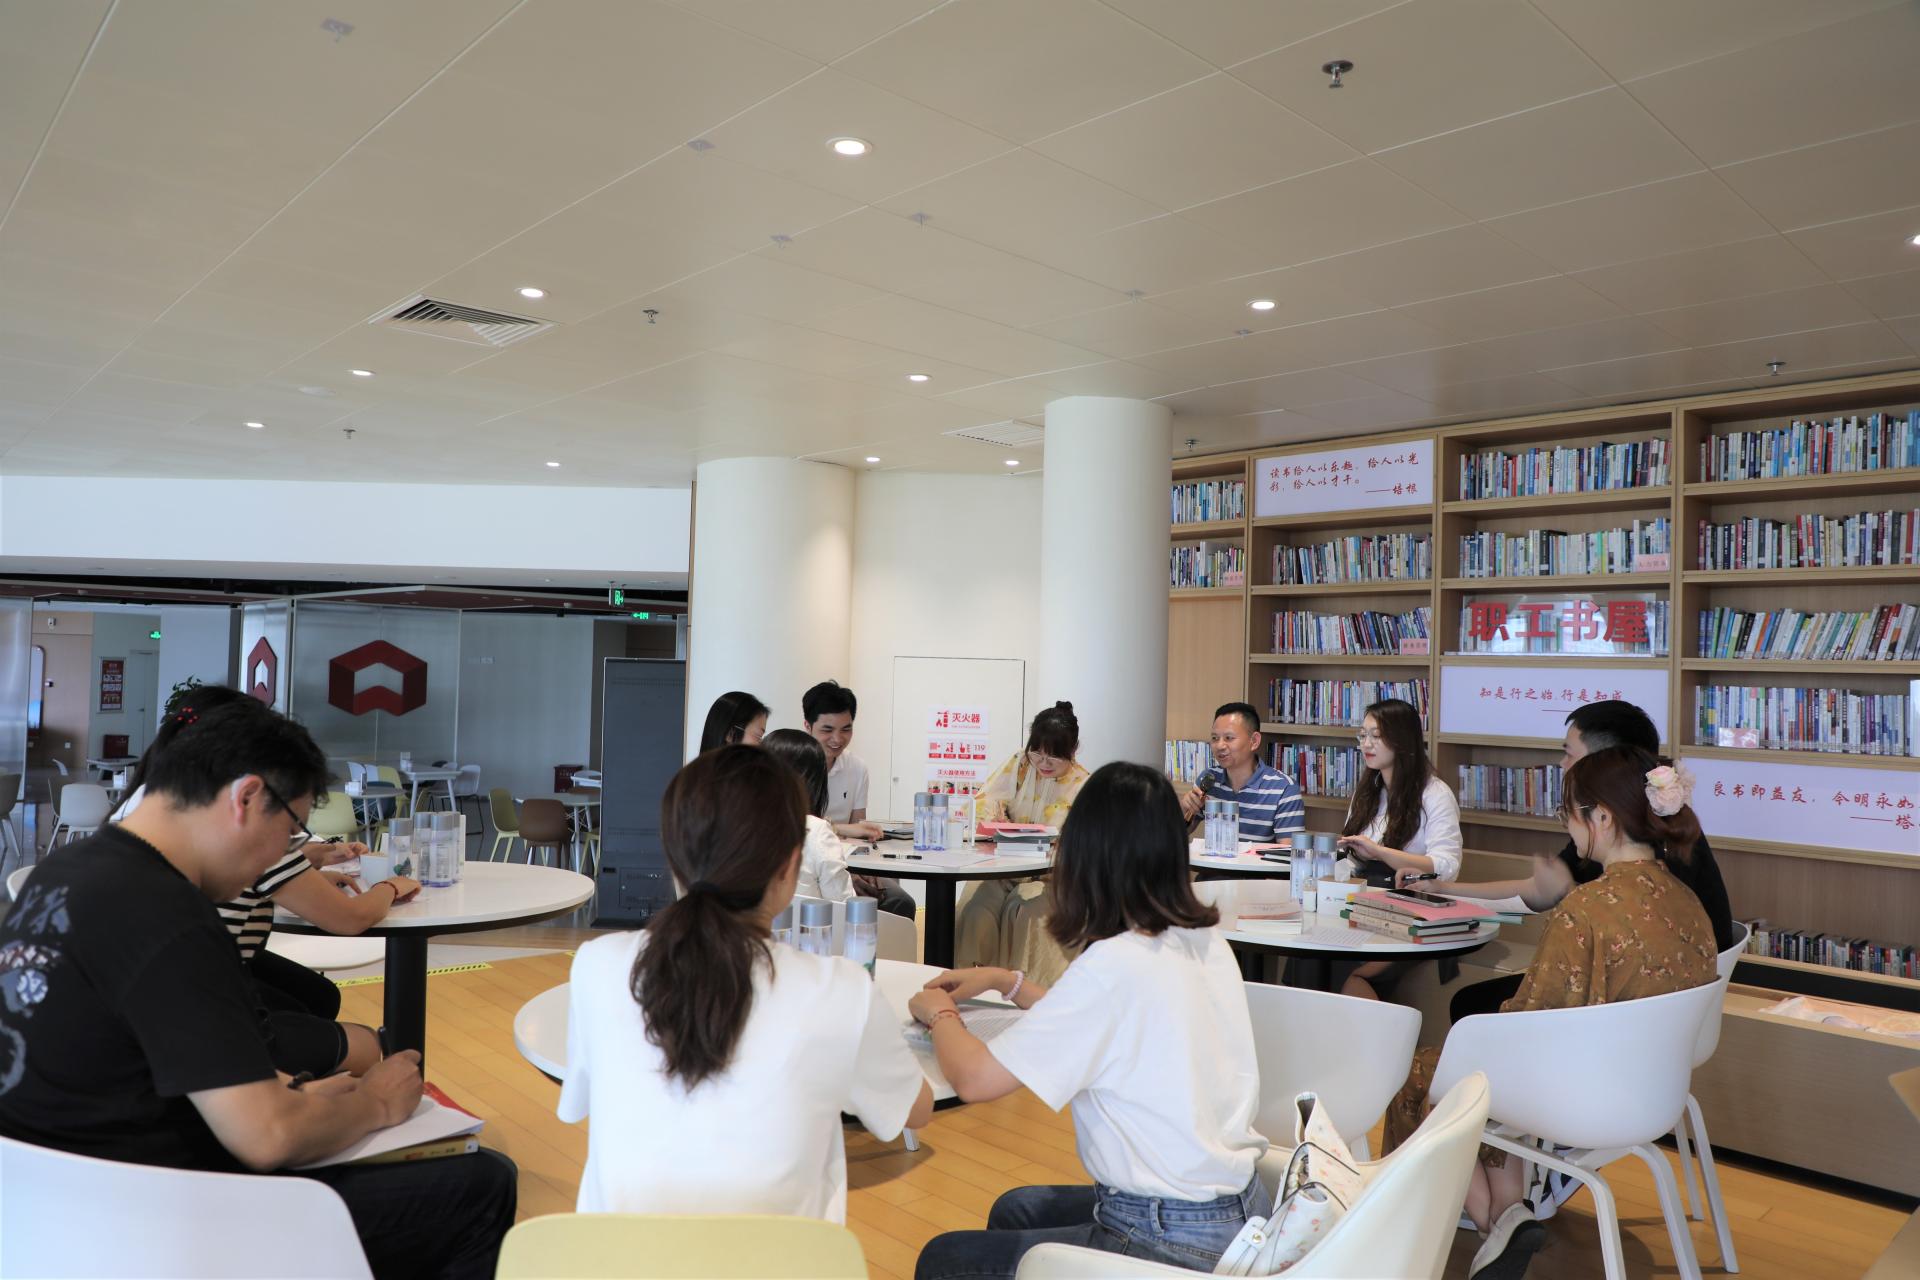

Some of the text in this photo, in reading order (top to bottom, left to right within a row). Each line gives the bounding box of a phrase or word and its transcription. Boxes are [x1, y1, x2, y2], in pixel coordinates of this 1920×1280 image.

[1468, 600, 1649, 642] 职工书屋
[952, 712, 981, 723] 灭火器
[1713, 780, 1920, 810] 良书即益友，今明永如
